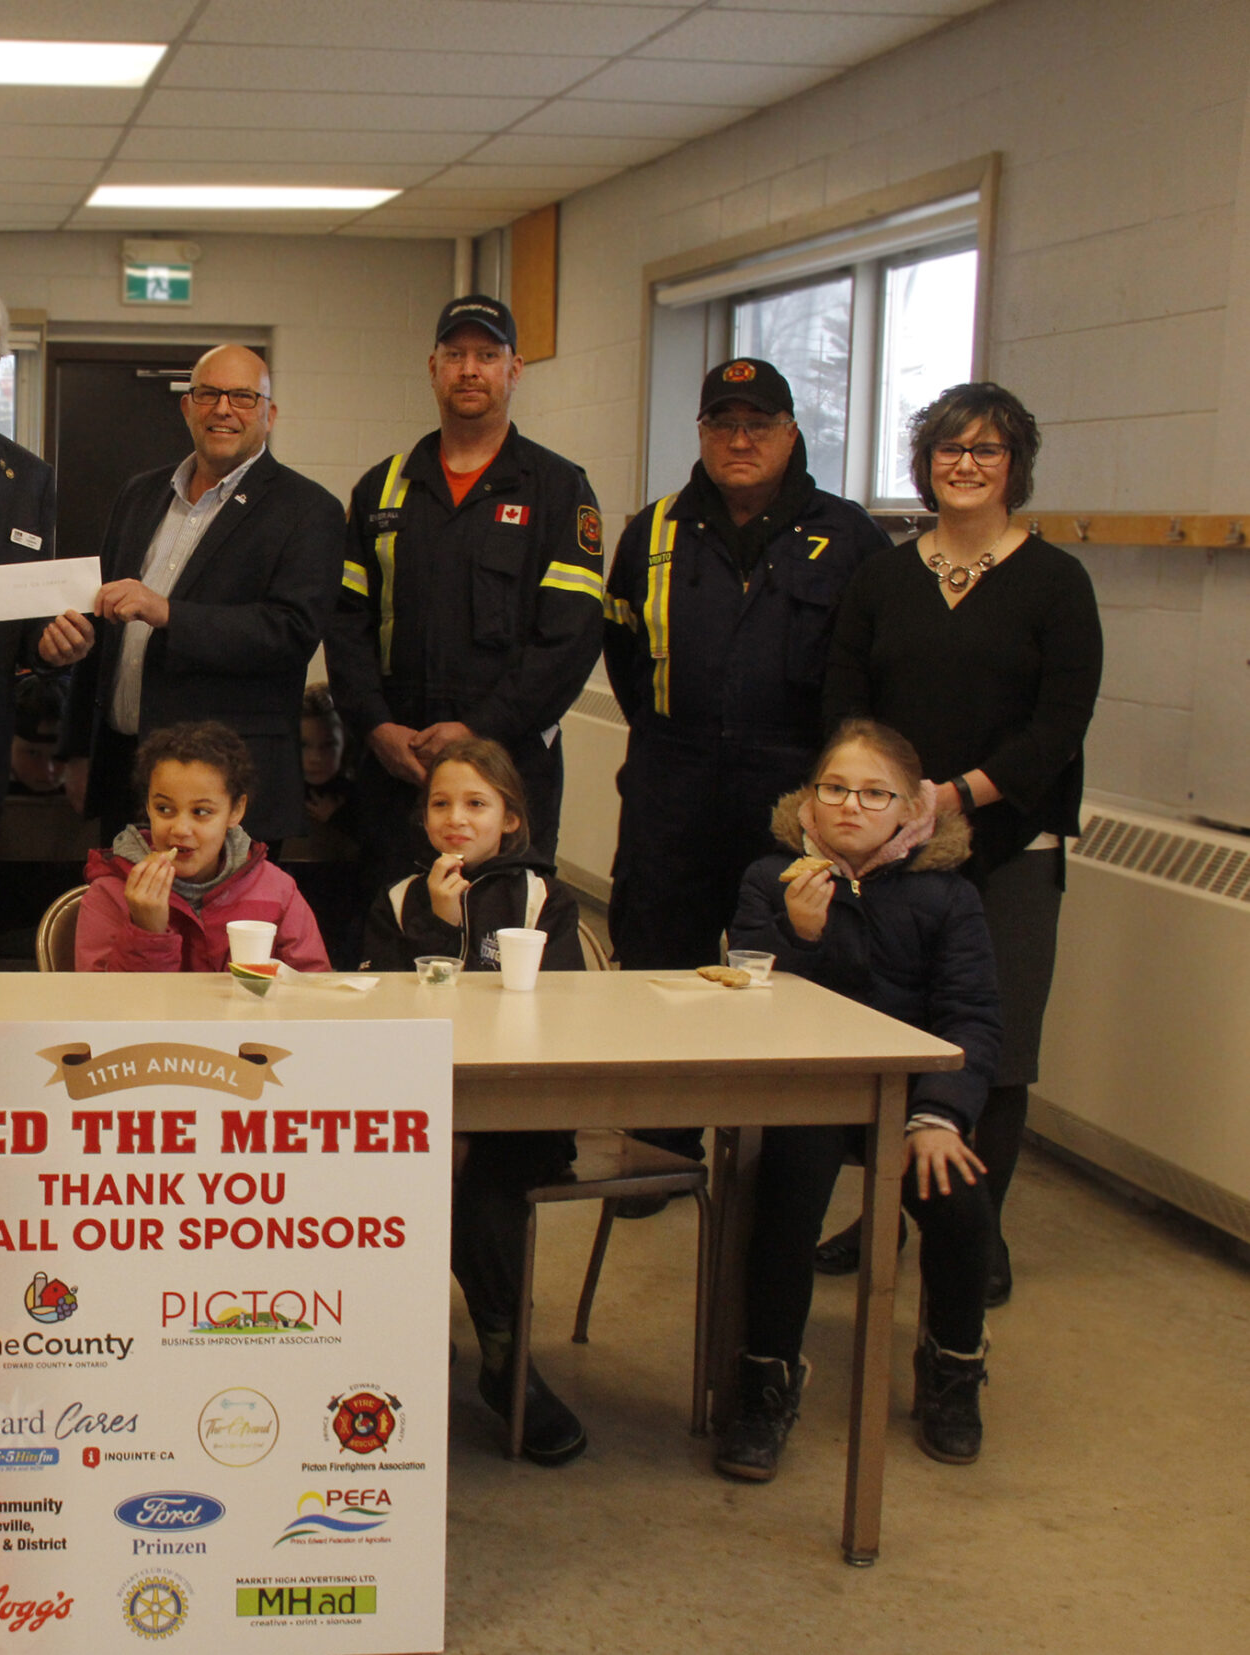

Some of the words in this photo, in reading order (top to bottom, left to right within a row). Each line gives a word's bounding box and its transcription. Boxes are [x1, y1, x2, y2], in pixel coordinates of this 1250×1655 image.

[807, 536, 830, 560] 7
[87, 1060, 137, 1086] 11TH
[147, 1057, 239, 1087] ANNUAL
[71, 1110, 197, 1155] THE
[220, 1109, 430, 1153] METER
[38, 1173, 185, 1206] THANK
[198, 1172, 285, 1204] YOU
[72, 1218, 165, 1250] OUR
[178, 1216, 406, 1249] SPONSORS
[162, 1289, 342, 1328] PICTON
[161, 1337, 206, 1346] BUSINESS
[207, 1336, 276, 1345] IMPROVEMENT
[279, 1335, 342, 1345] ASSOCIATION
[3, 1361, 34, 1369] EDWARD
[36, 1361, 67, 1369] COUNTY
[75, 1360, 108, 1368] ONTARIO
[54, 1401, 139, 1440] Cares
[302, 1463, 327, 1472] Picton
[330, 1462, 376, 1473] Firefighters
[378, 1461, 426, 1470] Association
[326, 1488, 392, 1507] PEFA
[136, 1497, 203, 1525] Ford
[2, 1538, 13, 1550] &
[17, 1537, 67, 1550] District
[133, 1538, 207, 1555] Prinzen
[236, 1577, 272, 1585] MARKET
[250, 1619, 287, 1627] creative
